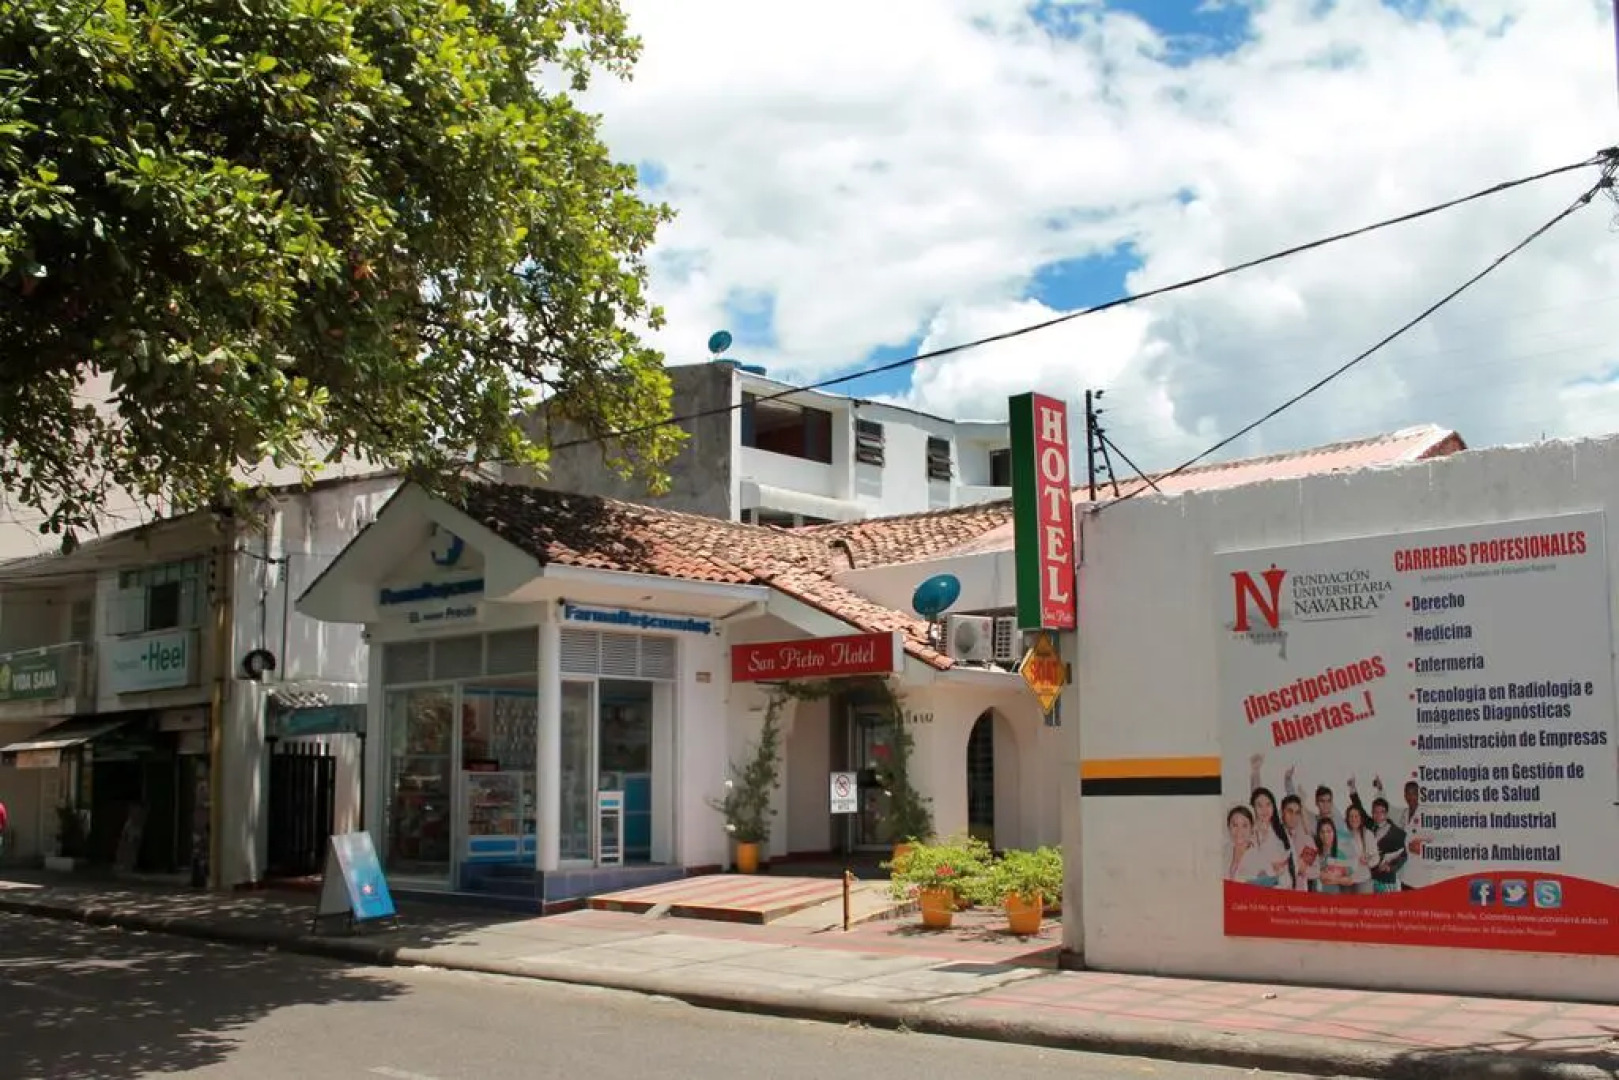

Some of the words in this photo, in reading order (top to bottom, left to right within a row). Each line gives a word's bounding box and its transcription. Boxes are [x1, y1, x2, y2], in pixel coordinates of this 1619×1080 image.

[1040, 407, 1068, 604] HOTEL
[1394, 543, 1467, 572] CARRERAS
[1470, 531, 1587, 564] PROFESIONALES
[1292, 569, 1370, 587] FUNDACIÓN
[1293, 581, 1393, 599] UNIVERSITARIA
[1412, 593, 1465, 611] Derecho
[1414, 623, 1472, 641] Medicina
[747, 651, 775, 672] San
[779, 647, 825, 670] Pietro
[830, 641, 875, 666] Hotel
[1489, 685, 1506, 700] en
[1584, 681, 1594, 696] e
[1417, 706, 1480, 724] Imágenes
[1483, 701, 1571, 722] Diagnósticas
[1418, 730, 1517, 750] Administración
[1519, 730, 1536, 746] de
[1540, 730, 1607, 749] Empresas
[1492, 764, 1509, 779] en
[1512, 761, 1563, 780] Gestión
[1567, 761, 1584, 779] de
[1420, 786, 1480, 803] Servicios
[1483, 785, 1499, 801] de
[1502, 785, 1540, 801] Salud
[1490, 812, 1557, 829] Industrial
[1491, 844, 1560, 861] Ambiental
